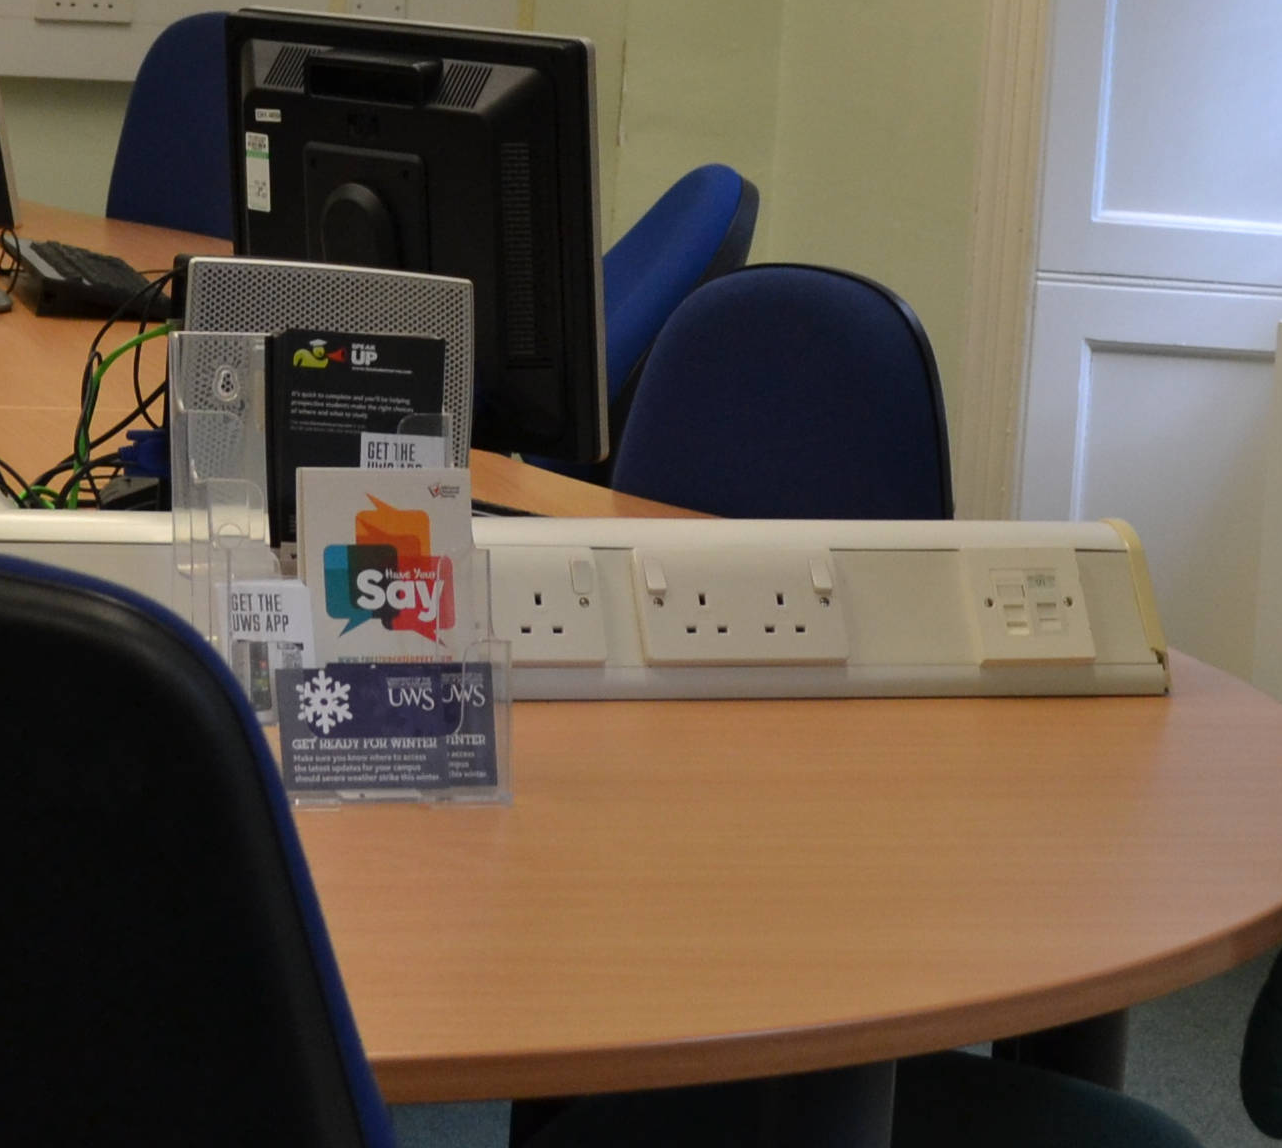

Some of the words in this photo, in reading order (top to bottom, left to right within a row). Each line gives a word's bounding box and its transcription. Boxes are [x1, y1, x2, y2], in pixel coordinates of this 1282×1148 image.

[350, 349, 378, 366] UP
[367, 441, 389, 461] GET
[393, 443, 415, 461] THE
[231, 593, 253, 612] GET
[258, 593, 282, 612] THE
[356, 569, 444, 622] Say
[232, 613, 261, 632] UWS
[266, 614, 289, 632] APP
[388, 687, 435, 711] UWS
[292, 737, 316, 750] GET
[320, 738, 359, 750] READY
[391, 737, 437, 749] WINTER
